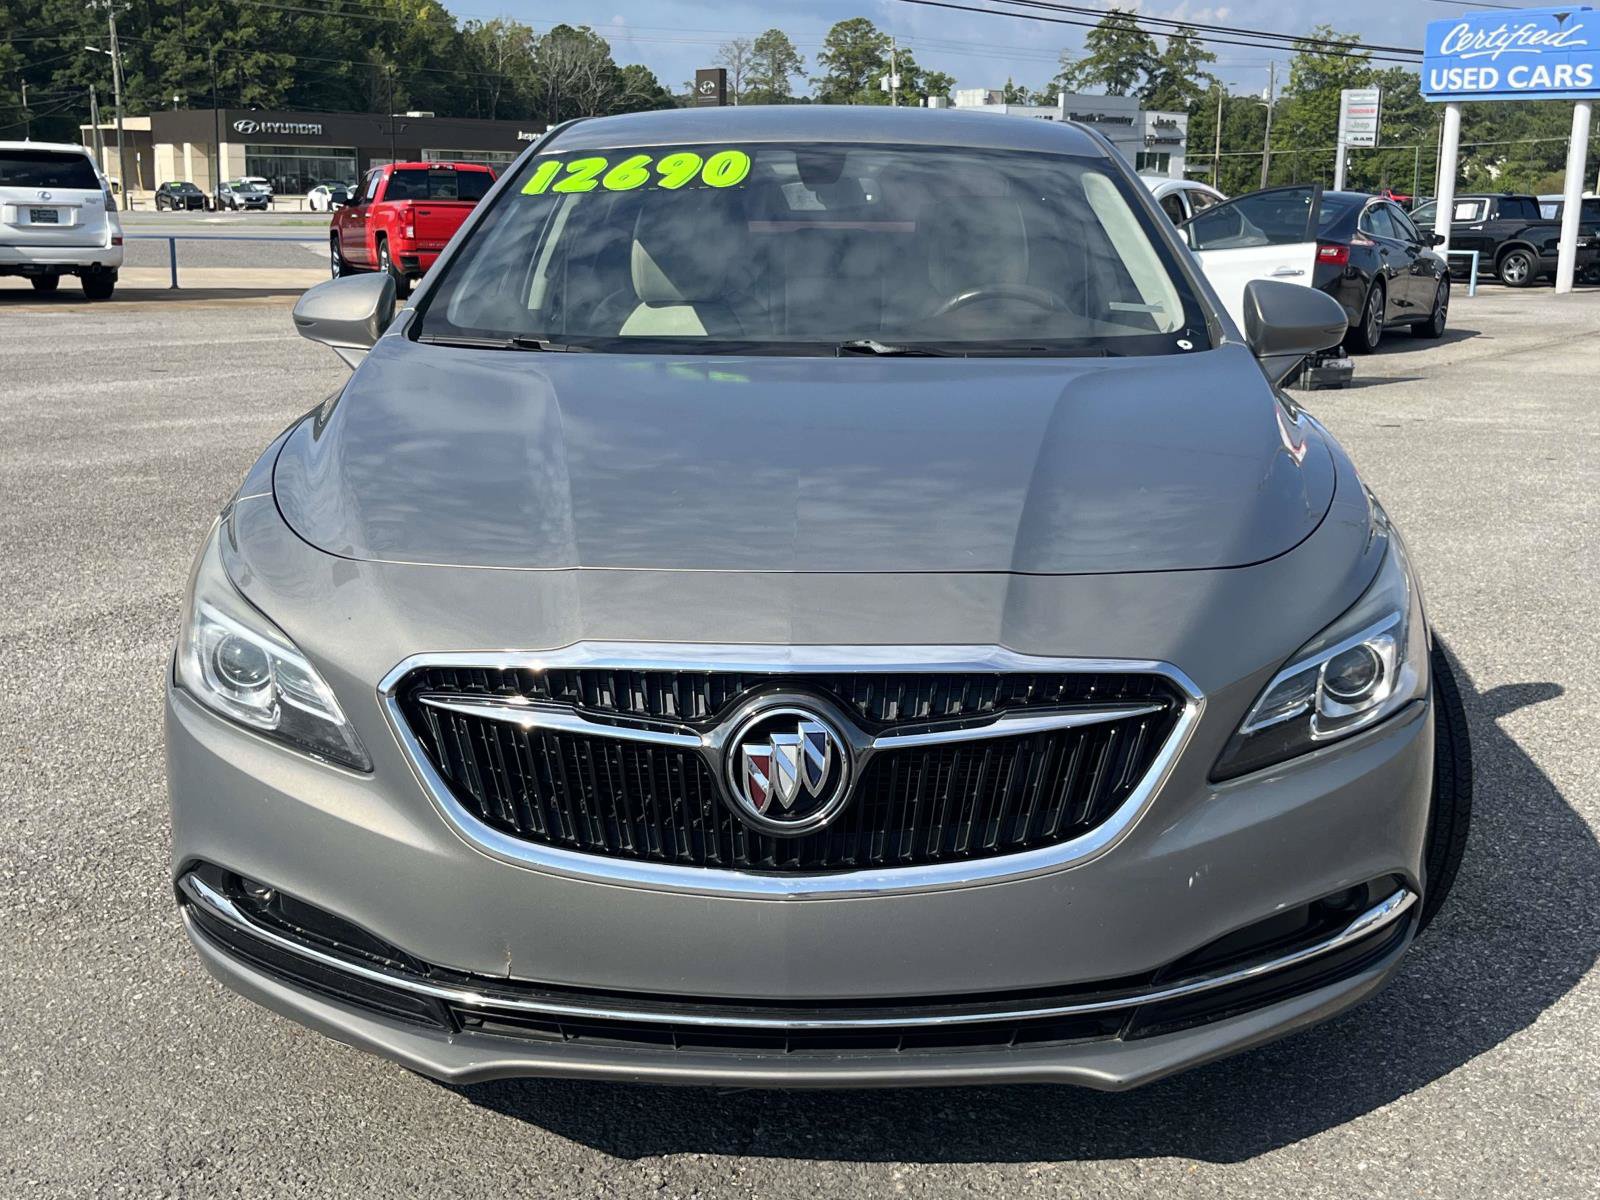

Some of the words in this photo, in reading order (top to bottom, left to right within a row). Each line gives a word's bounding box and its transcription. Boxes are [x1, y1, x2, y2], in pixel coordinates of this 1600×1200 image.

[1440, 23, 1588, 61] Certified
[1430, 67, 1499, 91] USED
[1507, 63, 1593, 88] CARS
[261, 121, 322, 135] HYUNDAI
[520, 150, 751, 195] 12690
